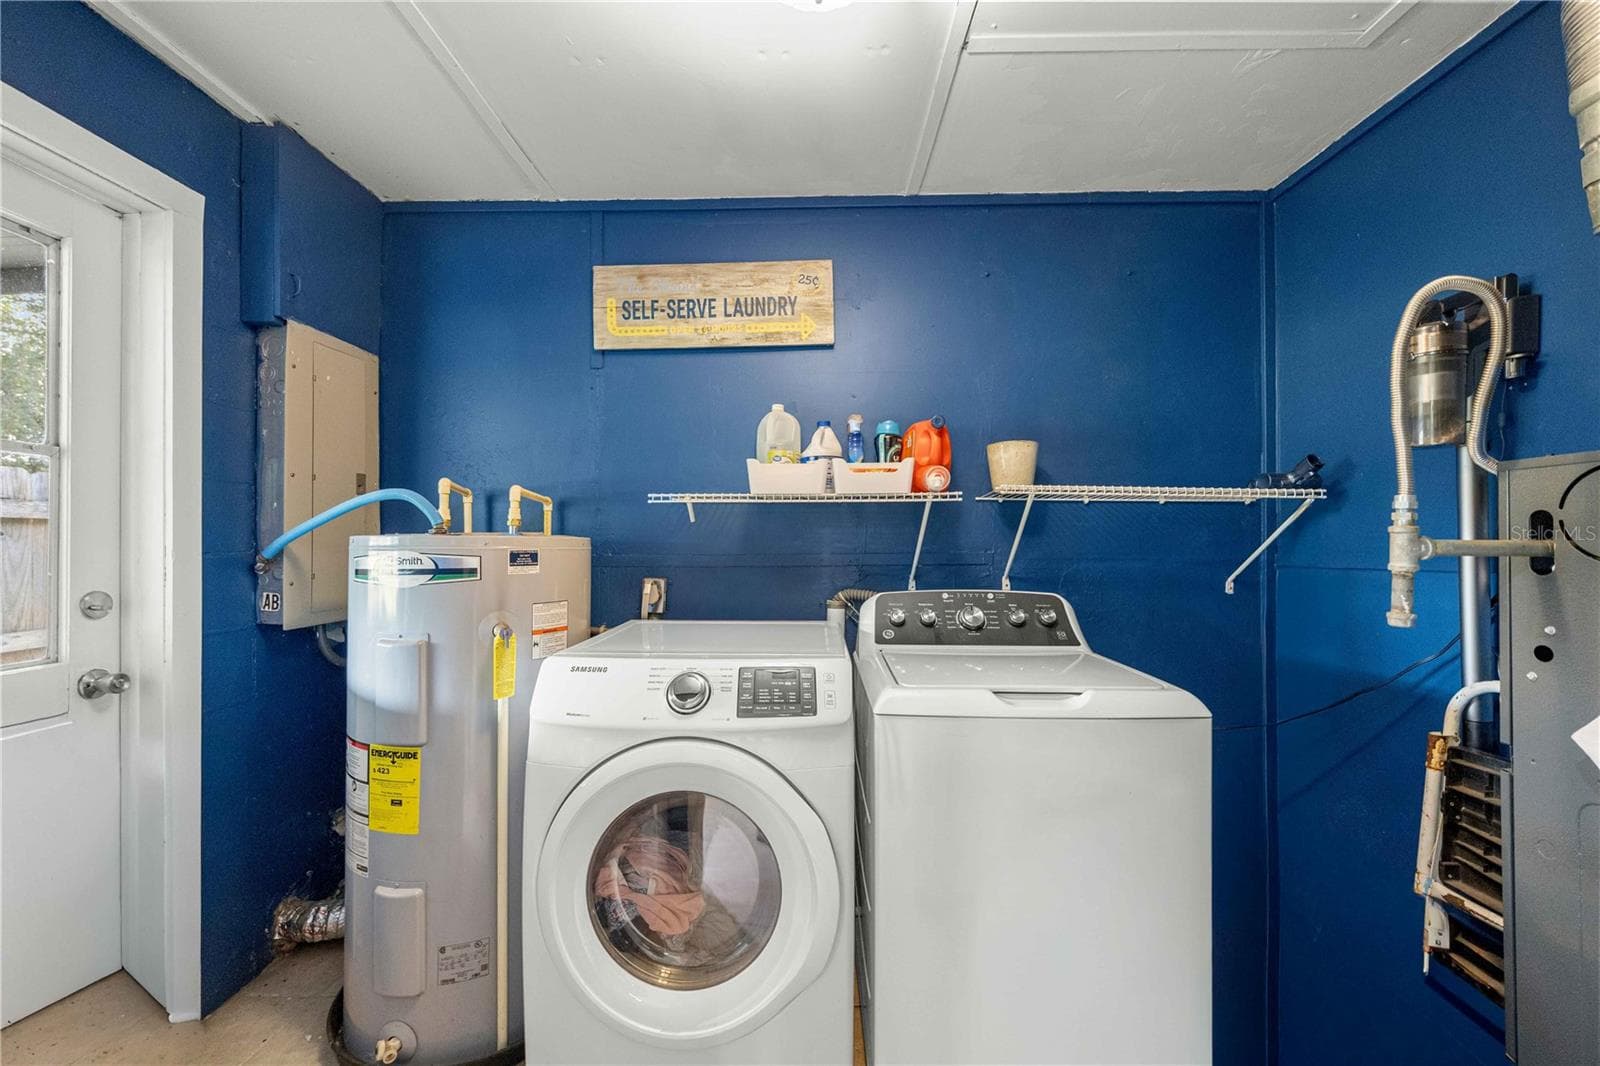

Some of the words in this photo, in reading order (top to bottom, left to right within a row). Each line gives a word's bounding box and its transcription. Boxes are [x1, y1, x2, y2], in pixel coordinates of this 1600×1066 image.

[621, 297, 717, 320] SELF-SERVE
[723, 296, 798, 318] LAUNDRY
[397, 556, 422, 566] Smith
[262, 593, 279, 610] AB
